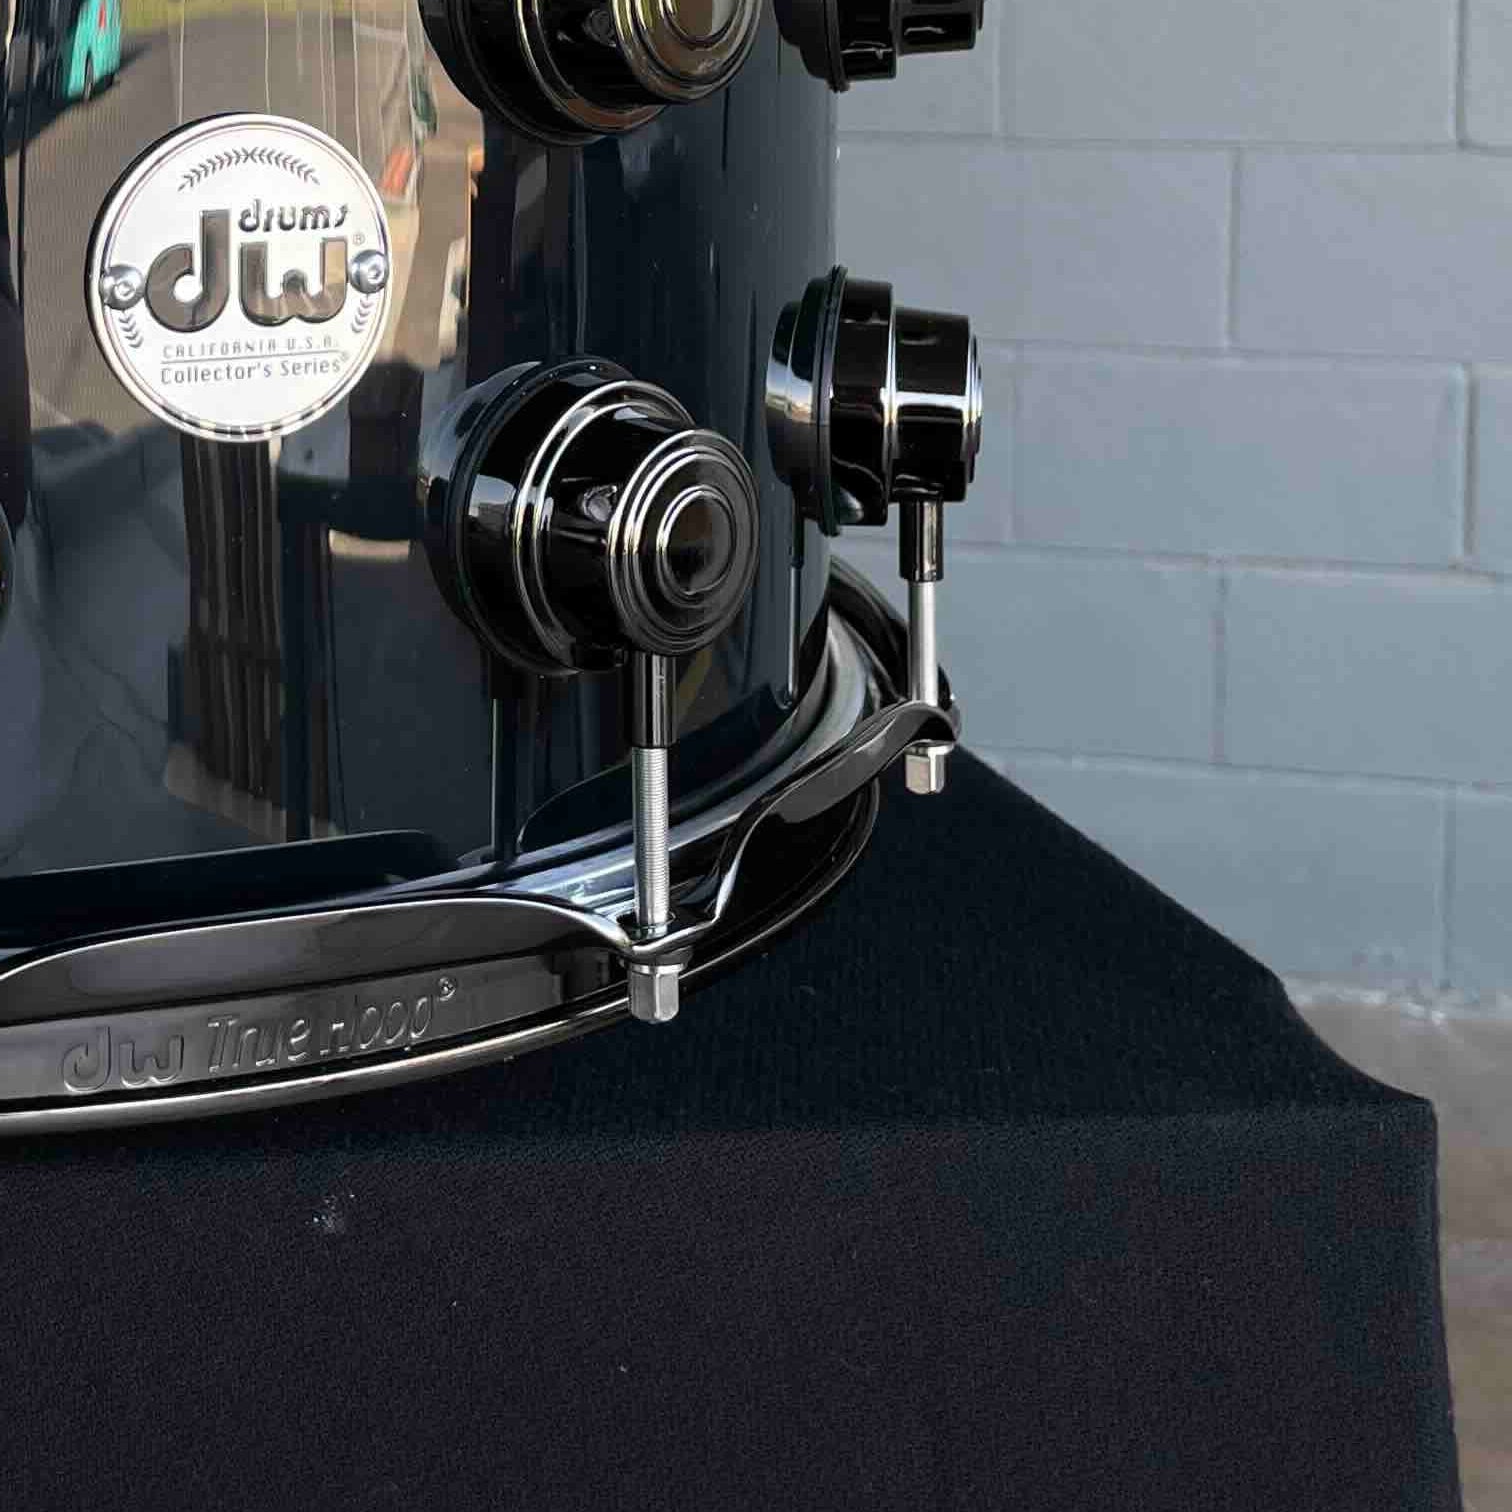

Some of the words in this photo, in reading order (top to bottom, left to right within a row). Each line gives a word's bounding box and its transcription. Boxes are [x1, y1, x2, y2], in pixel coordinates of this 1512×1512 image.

[238, 198, 350, 233] drums
[162, 337, 277, 360] CALIFORNIA
[160, 361, 273, 385] Collector's
[61, 1024, 186, 1093] dw
